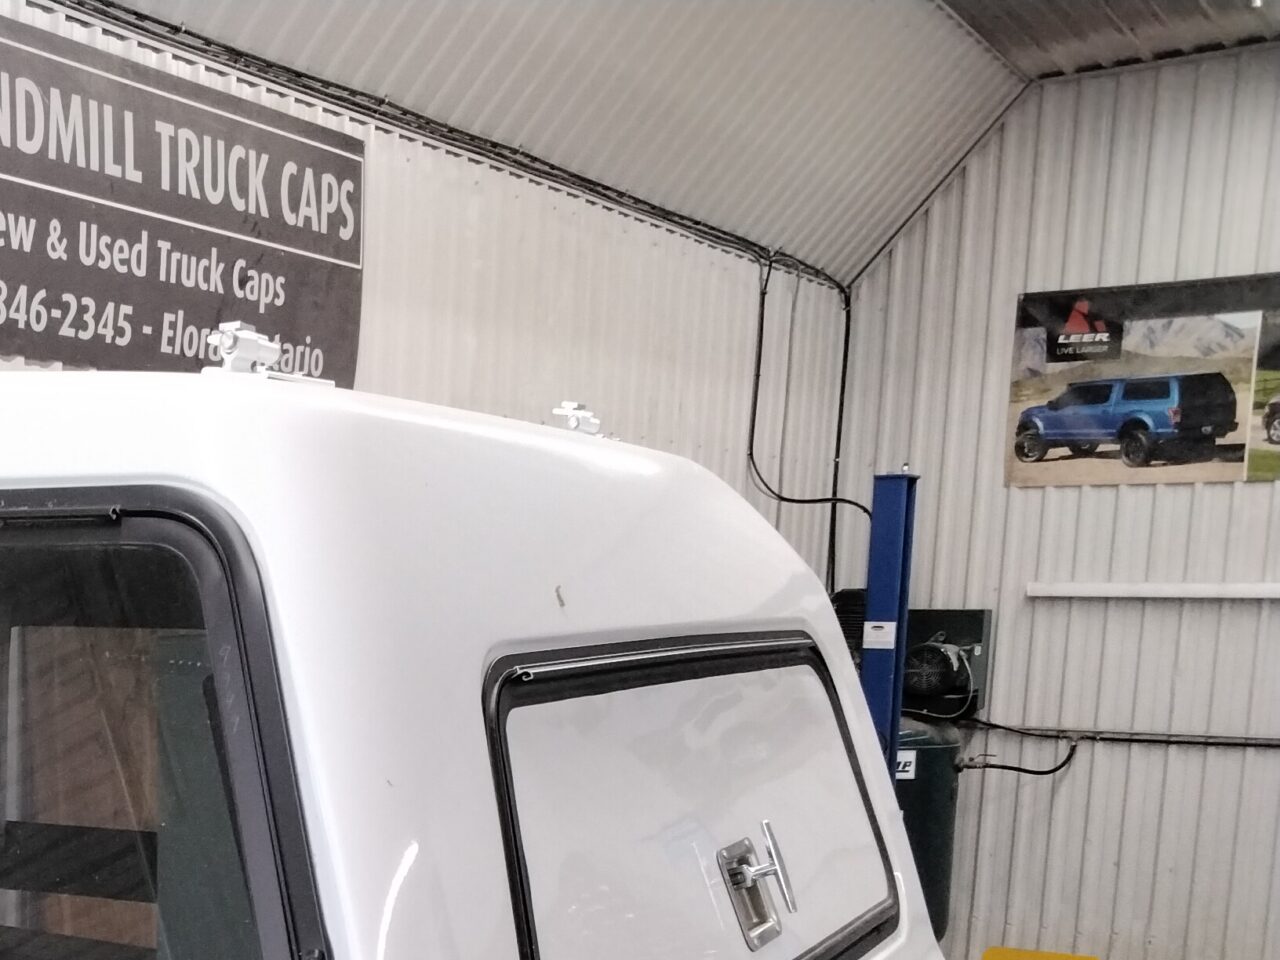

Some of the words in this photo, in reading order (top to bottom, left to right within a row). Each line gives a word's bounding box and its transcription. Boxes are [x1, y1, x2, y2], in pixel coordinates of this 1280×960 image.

[154, 119, 270, 219] TRUCK
[280, 160, 355, 241] CAPS
[46, 218, 68, 262] &
[78, 220, 149, 278] Used
[157, 239, 225, 294] Truck
[232, 258, 286, 314] Caps
[1057, 332, 1111, 344] LEER
